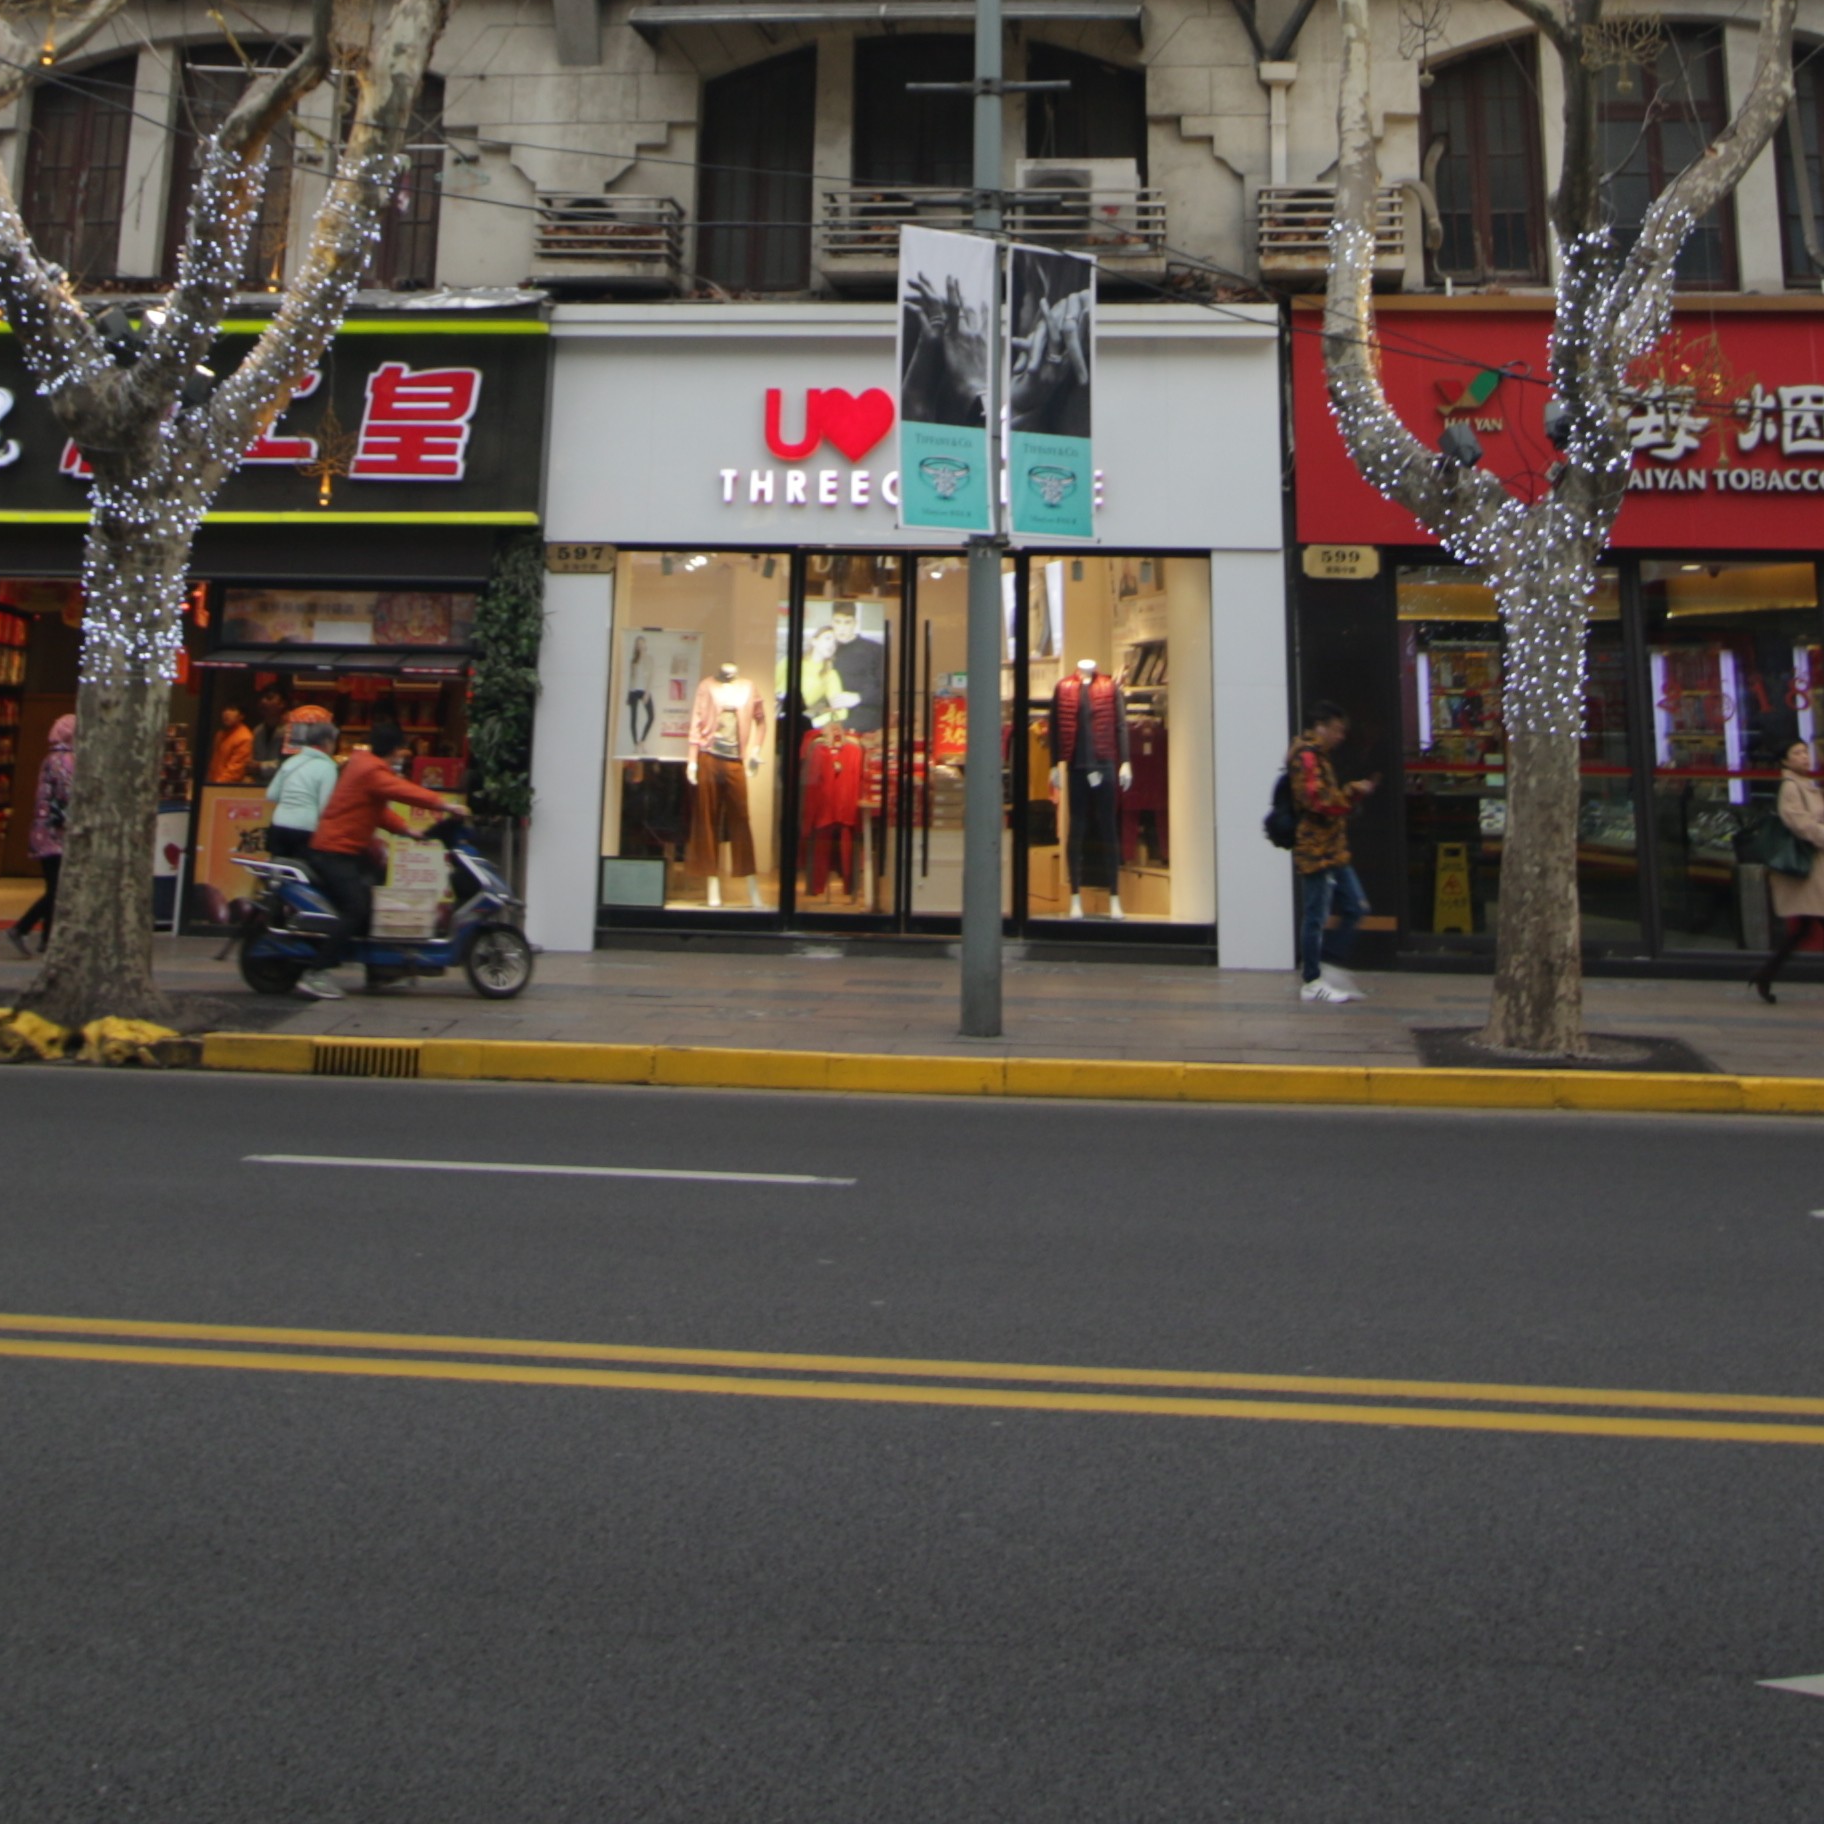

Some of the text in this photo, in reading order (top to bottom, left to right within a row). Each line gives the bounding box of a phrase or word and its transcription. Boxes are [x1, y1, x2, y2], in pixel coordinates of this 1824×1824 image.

[1474, 417, 1504, 432] YAN
[558, 546, 603, 560] 597
[1321, 550, 1360, 563] 599
